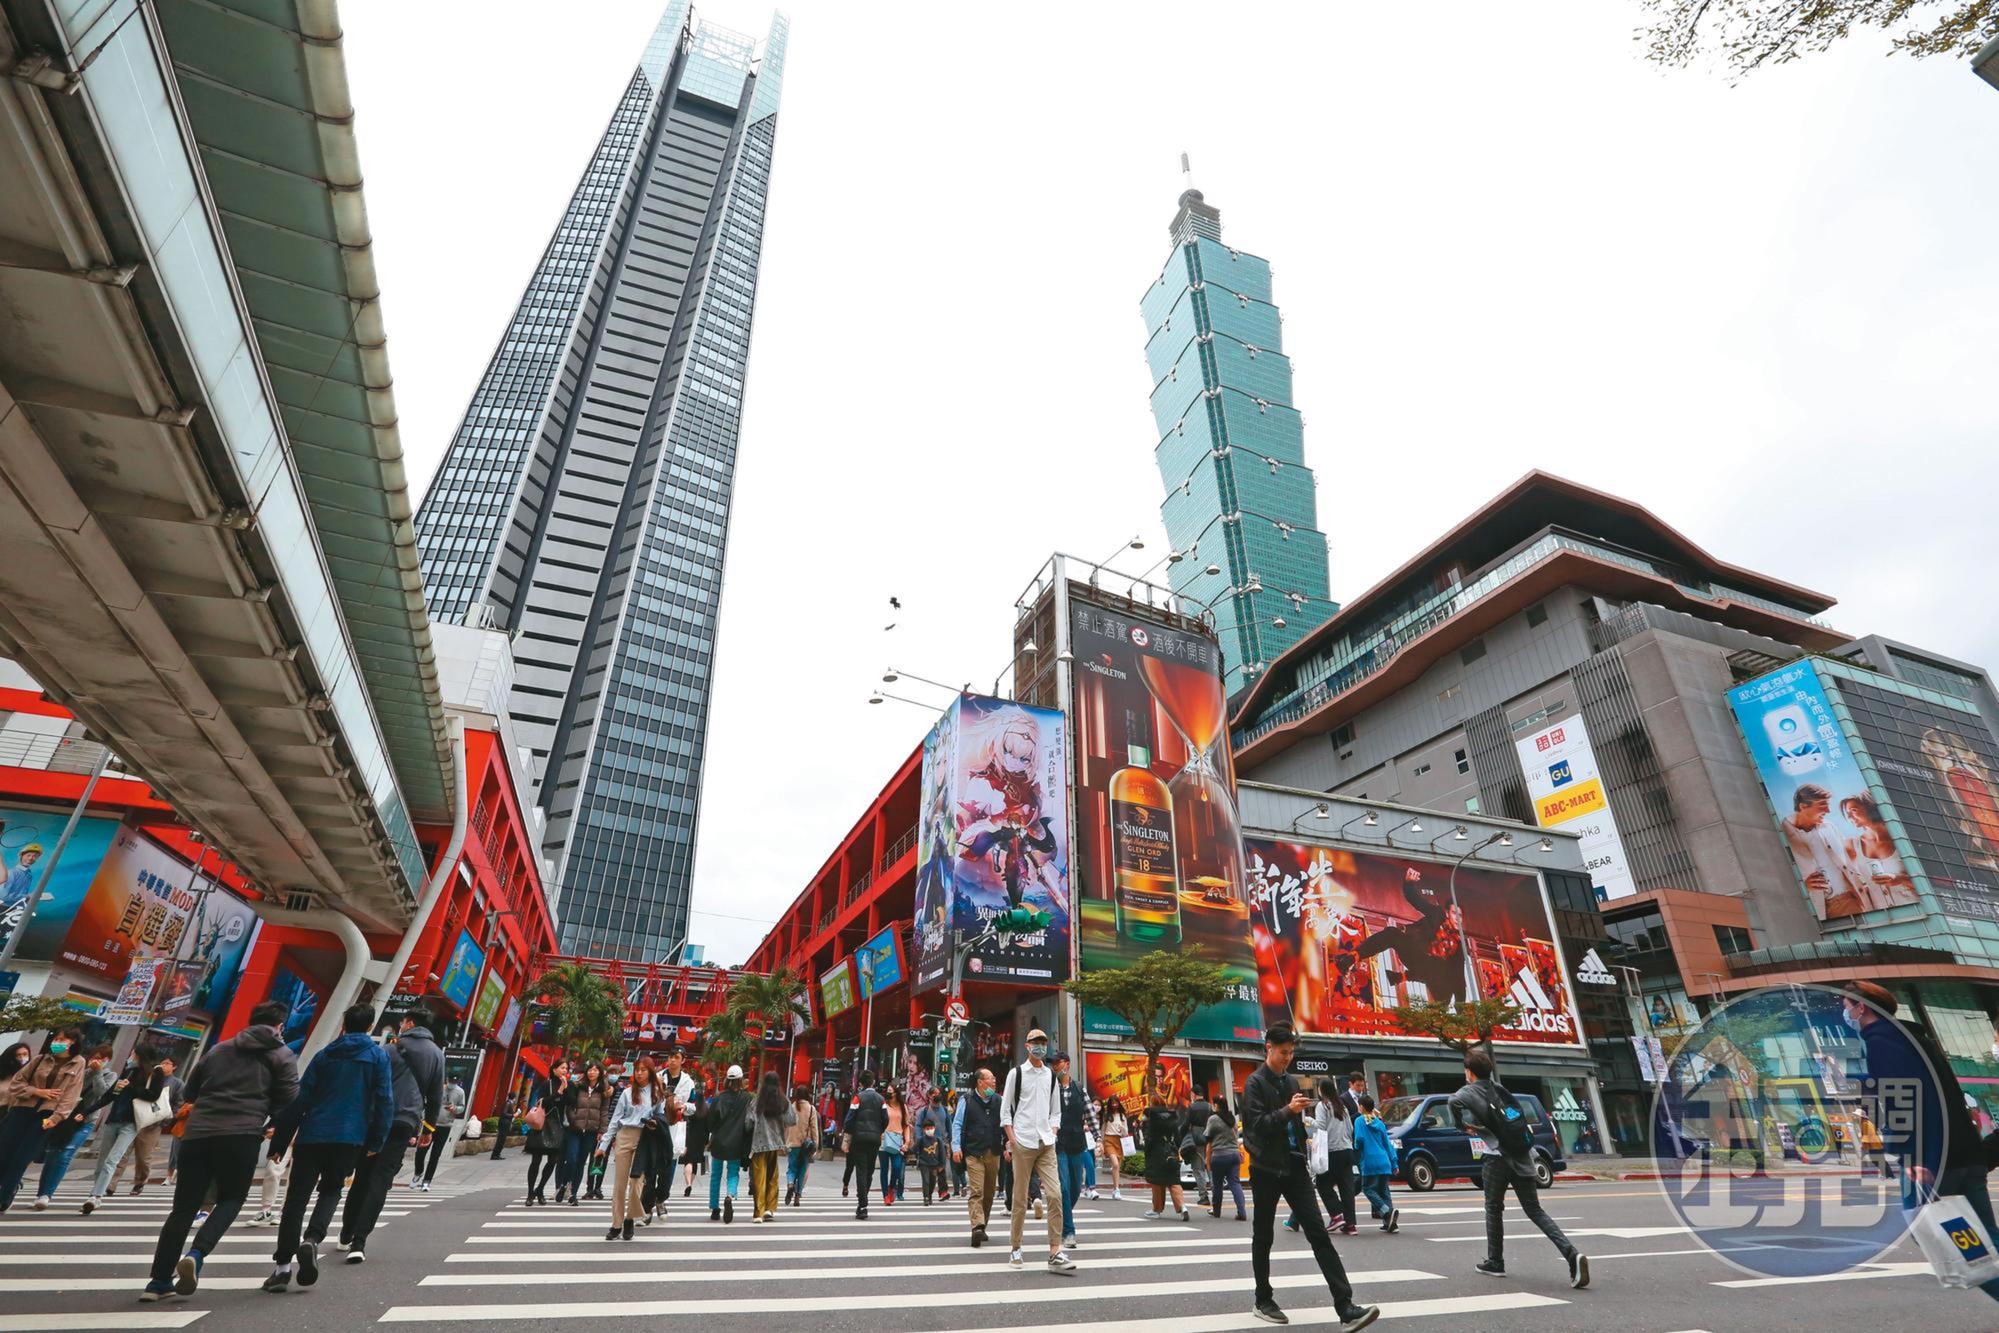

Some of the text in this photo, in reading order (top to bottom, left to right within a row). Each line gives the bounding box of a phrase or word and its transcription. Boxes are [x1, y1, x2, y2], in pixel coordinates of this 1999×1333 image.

[1077, 610, 1128, 643] 禁止酒駕
[1153, 632, 1207, 664] 酒後不開車
[1089, 661, 1126, 680] SINGLETON
[1551, 765, 1571, 781] GU
[1544, 790, 1596, 818] ABC-MART
[1123, 821, 1169, 842] SINGLETON
[1138, 858, 1150, 872] 18
[1577, 972, 1617, 985] adidas
[1297, 1061, 1329, 1071] SEIKO
[1552, 1110, 1587, 1121] adidas
[1951, 1228, 1980, 1250] GU
